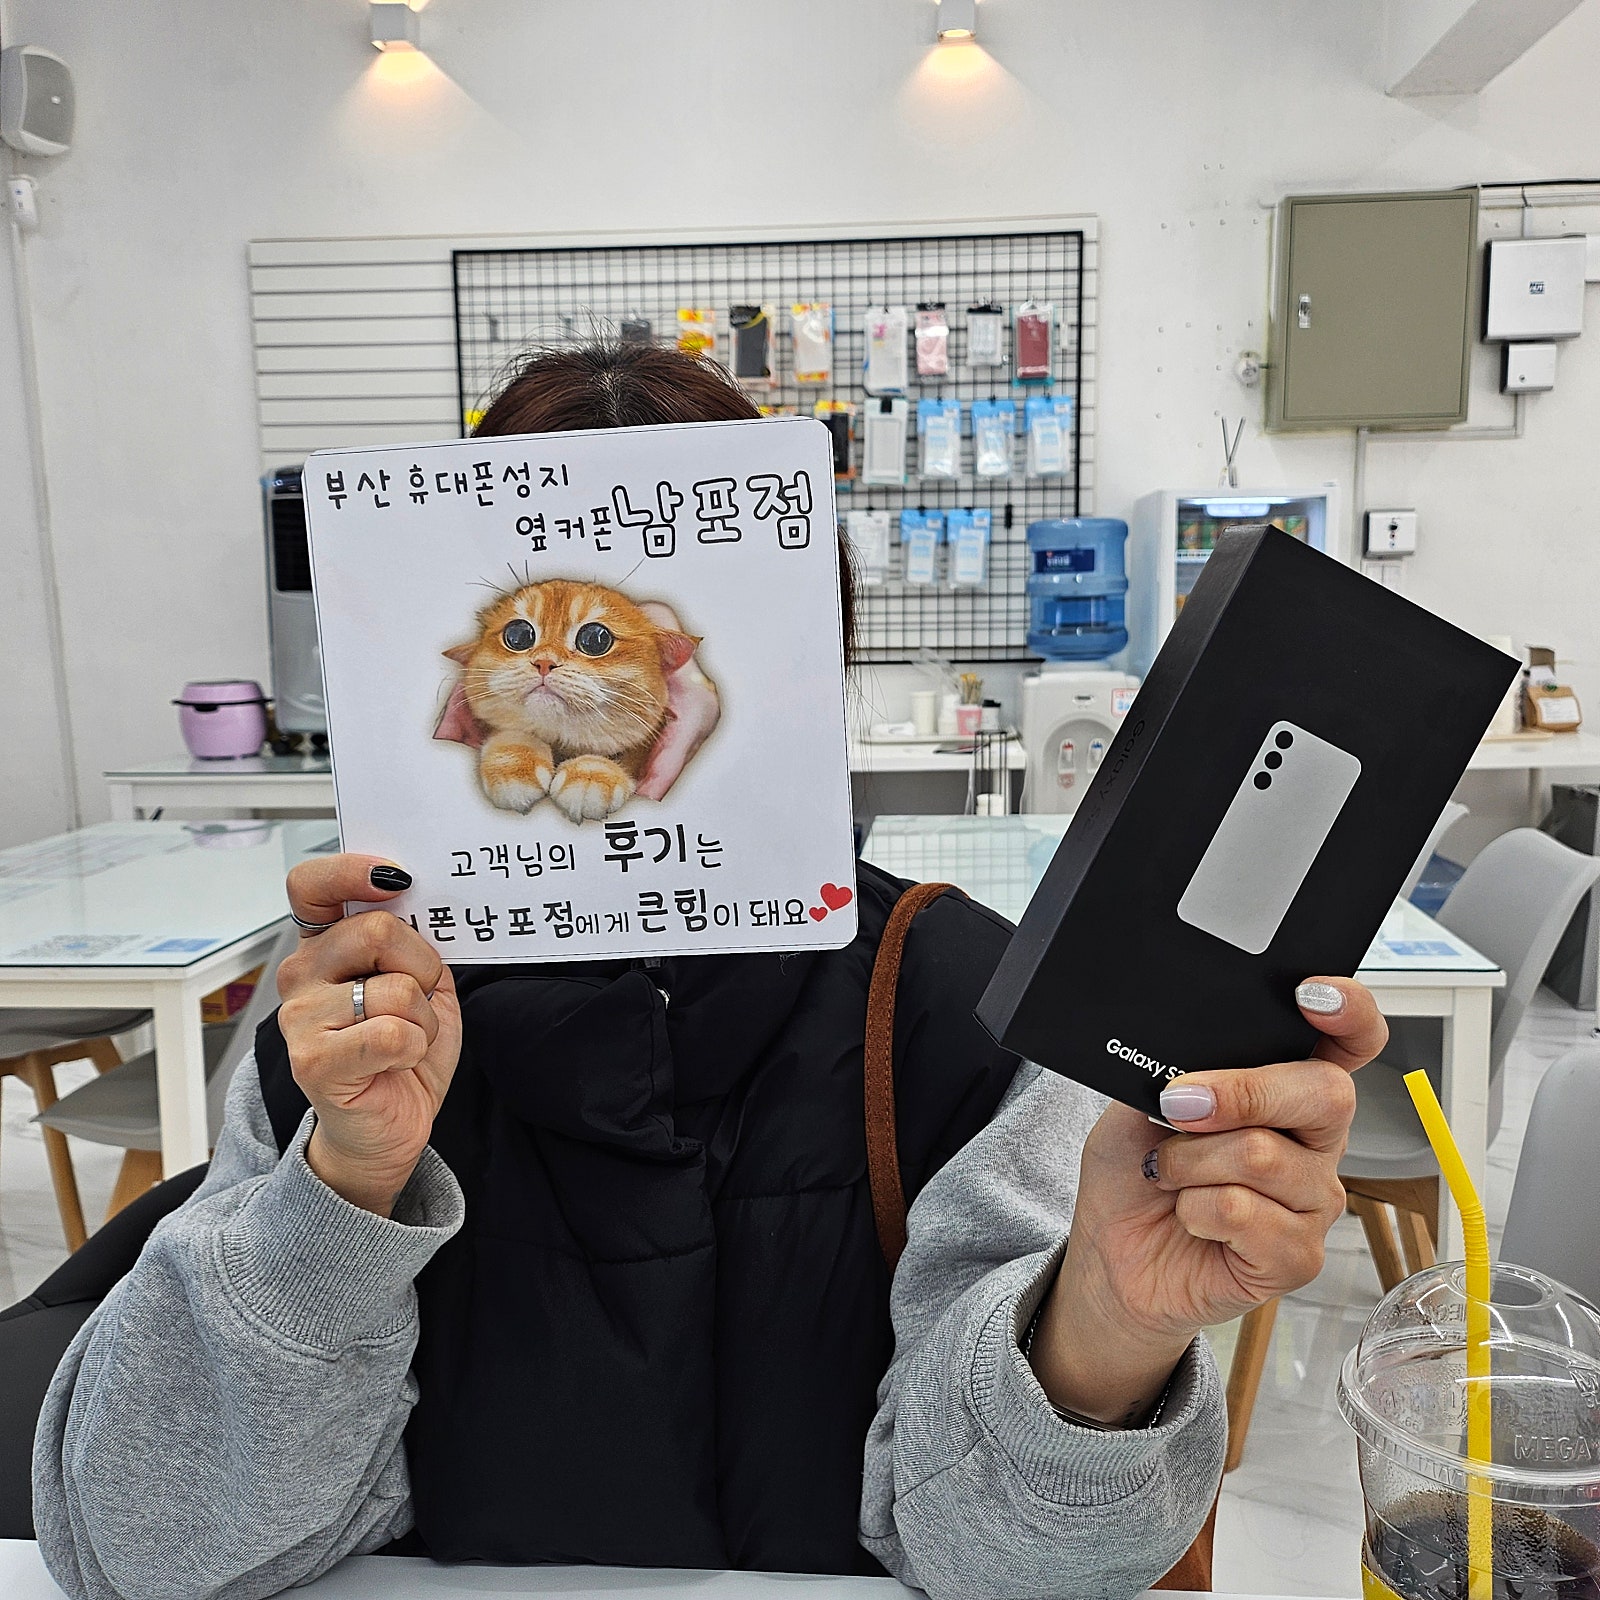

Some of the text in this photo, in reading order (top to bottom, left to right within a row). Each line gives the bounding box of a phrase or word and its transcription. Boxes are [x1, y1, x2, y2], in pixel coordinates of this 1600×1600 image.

[326, 469, 391, 510] 부산
[450, 820, 724, 879] 고객님의 후기는
[749, 898, 808, 927] 돼요
[1106, 1038, 1166, 1078] Galaxy
[1514, 1434, 1592, 1461] MEGA
